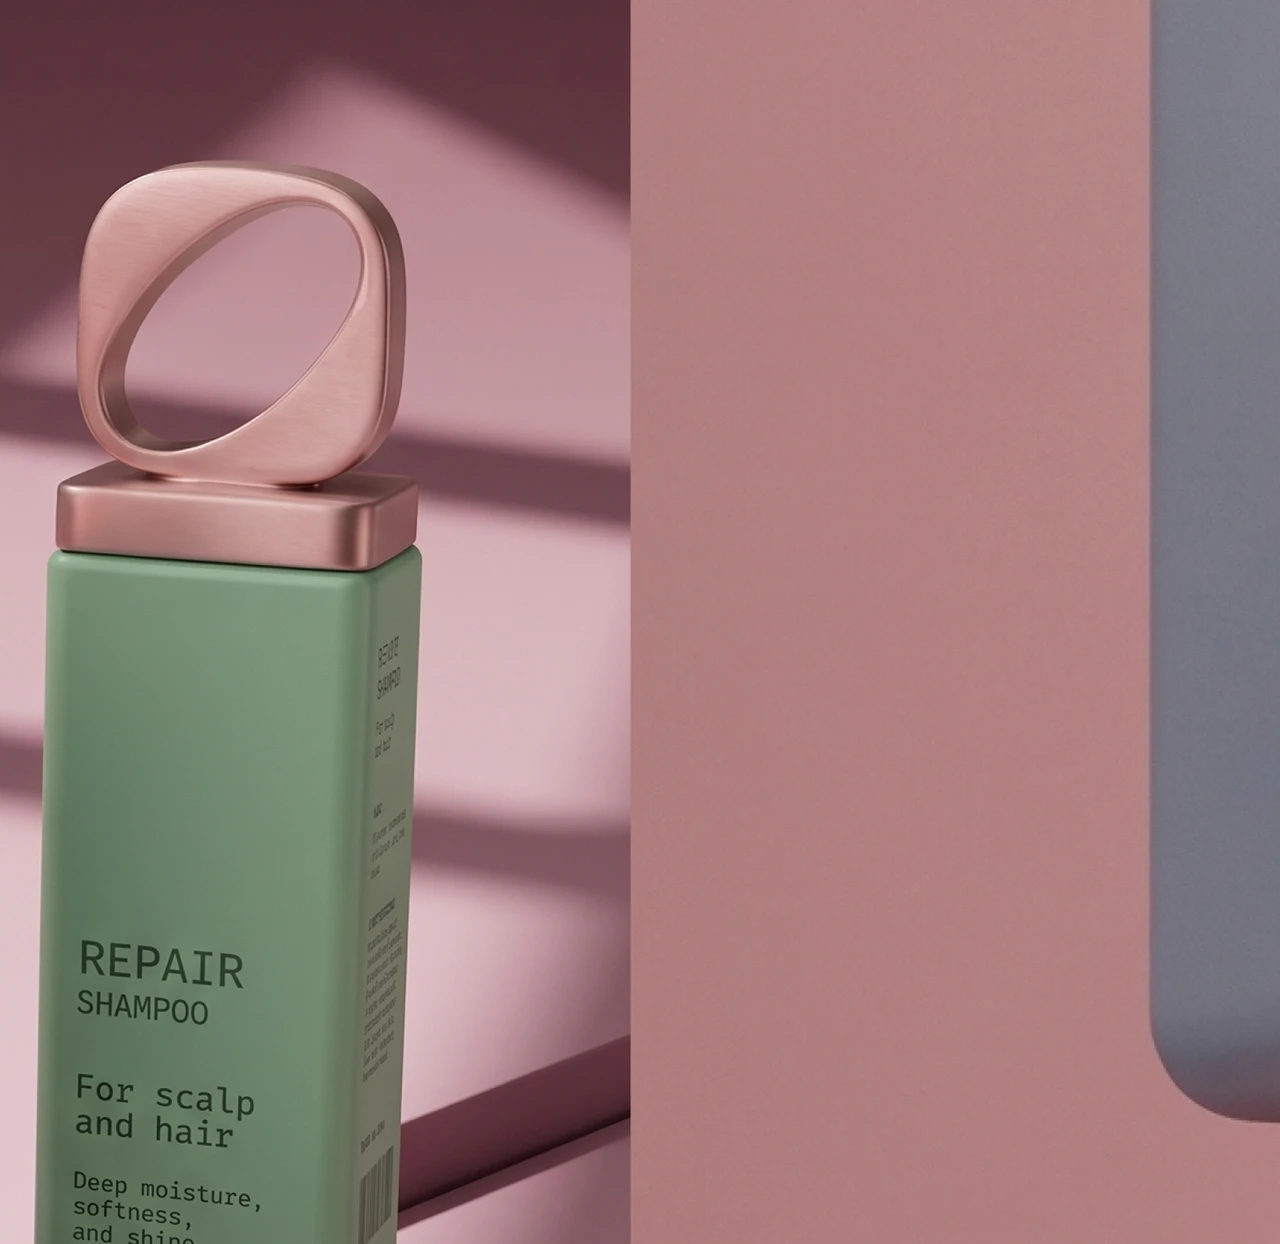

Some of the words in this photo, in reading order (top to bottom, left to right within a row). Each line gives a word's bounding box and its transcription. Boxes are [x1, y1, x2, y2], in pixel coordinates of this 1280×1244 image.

[80, 939, 244, 989] REPAIR
[77, 989, 209, 1026] SHAMPOO
[76, 1073, 134, 1103] For
[156, 1085, 255, 1121] scalp
[75, 1112, 133, 1139] and
[155, 1115, 234, 1148] hair
[73, 1171, 128, 1198] Deep
[140, 1180, 262, 1213] moisture,
[73, 1199, 193, 1231] softness,
[72, 1225, 113, 1244] and
